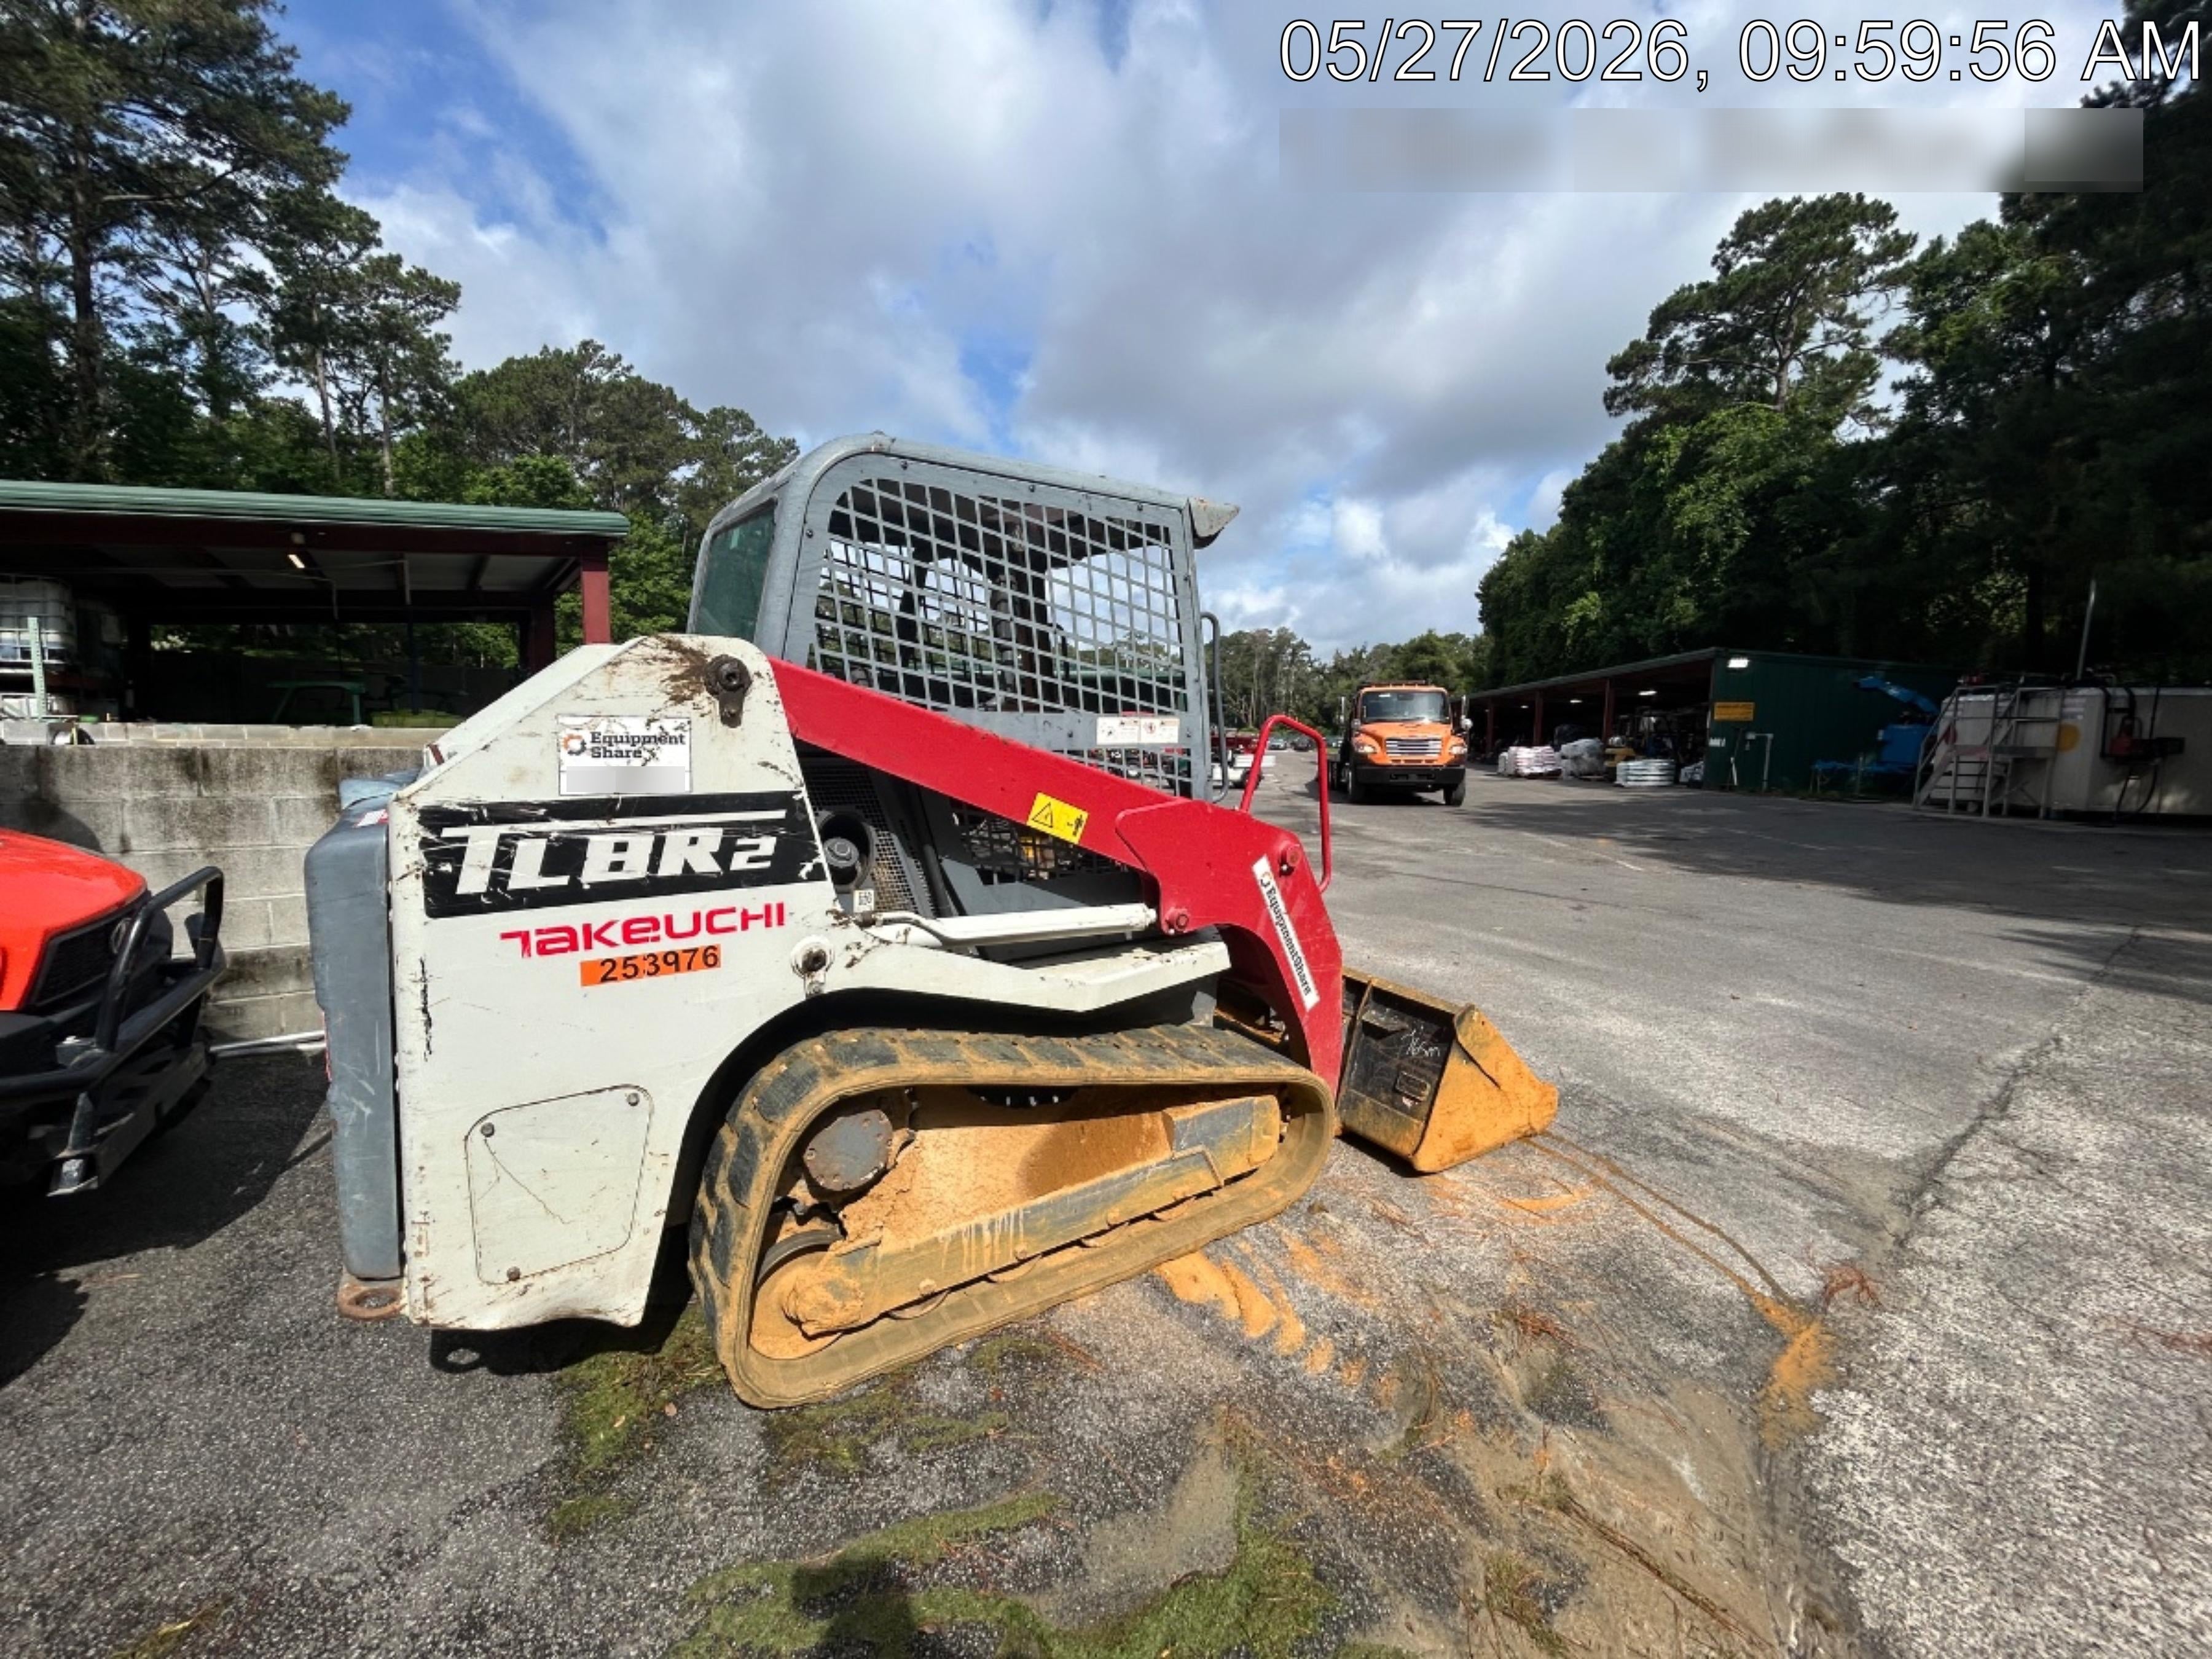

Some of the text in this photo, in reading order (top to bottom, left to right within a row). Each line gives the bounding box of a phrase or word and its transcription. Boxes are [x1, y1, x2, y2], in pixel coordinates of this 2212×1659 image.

[590, 731, 686, 747] Equipment
[590, 746, 643, 759] Share
[600, 945, 719, 983] 253976
